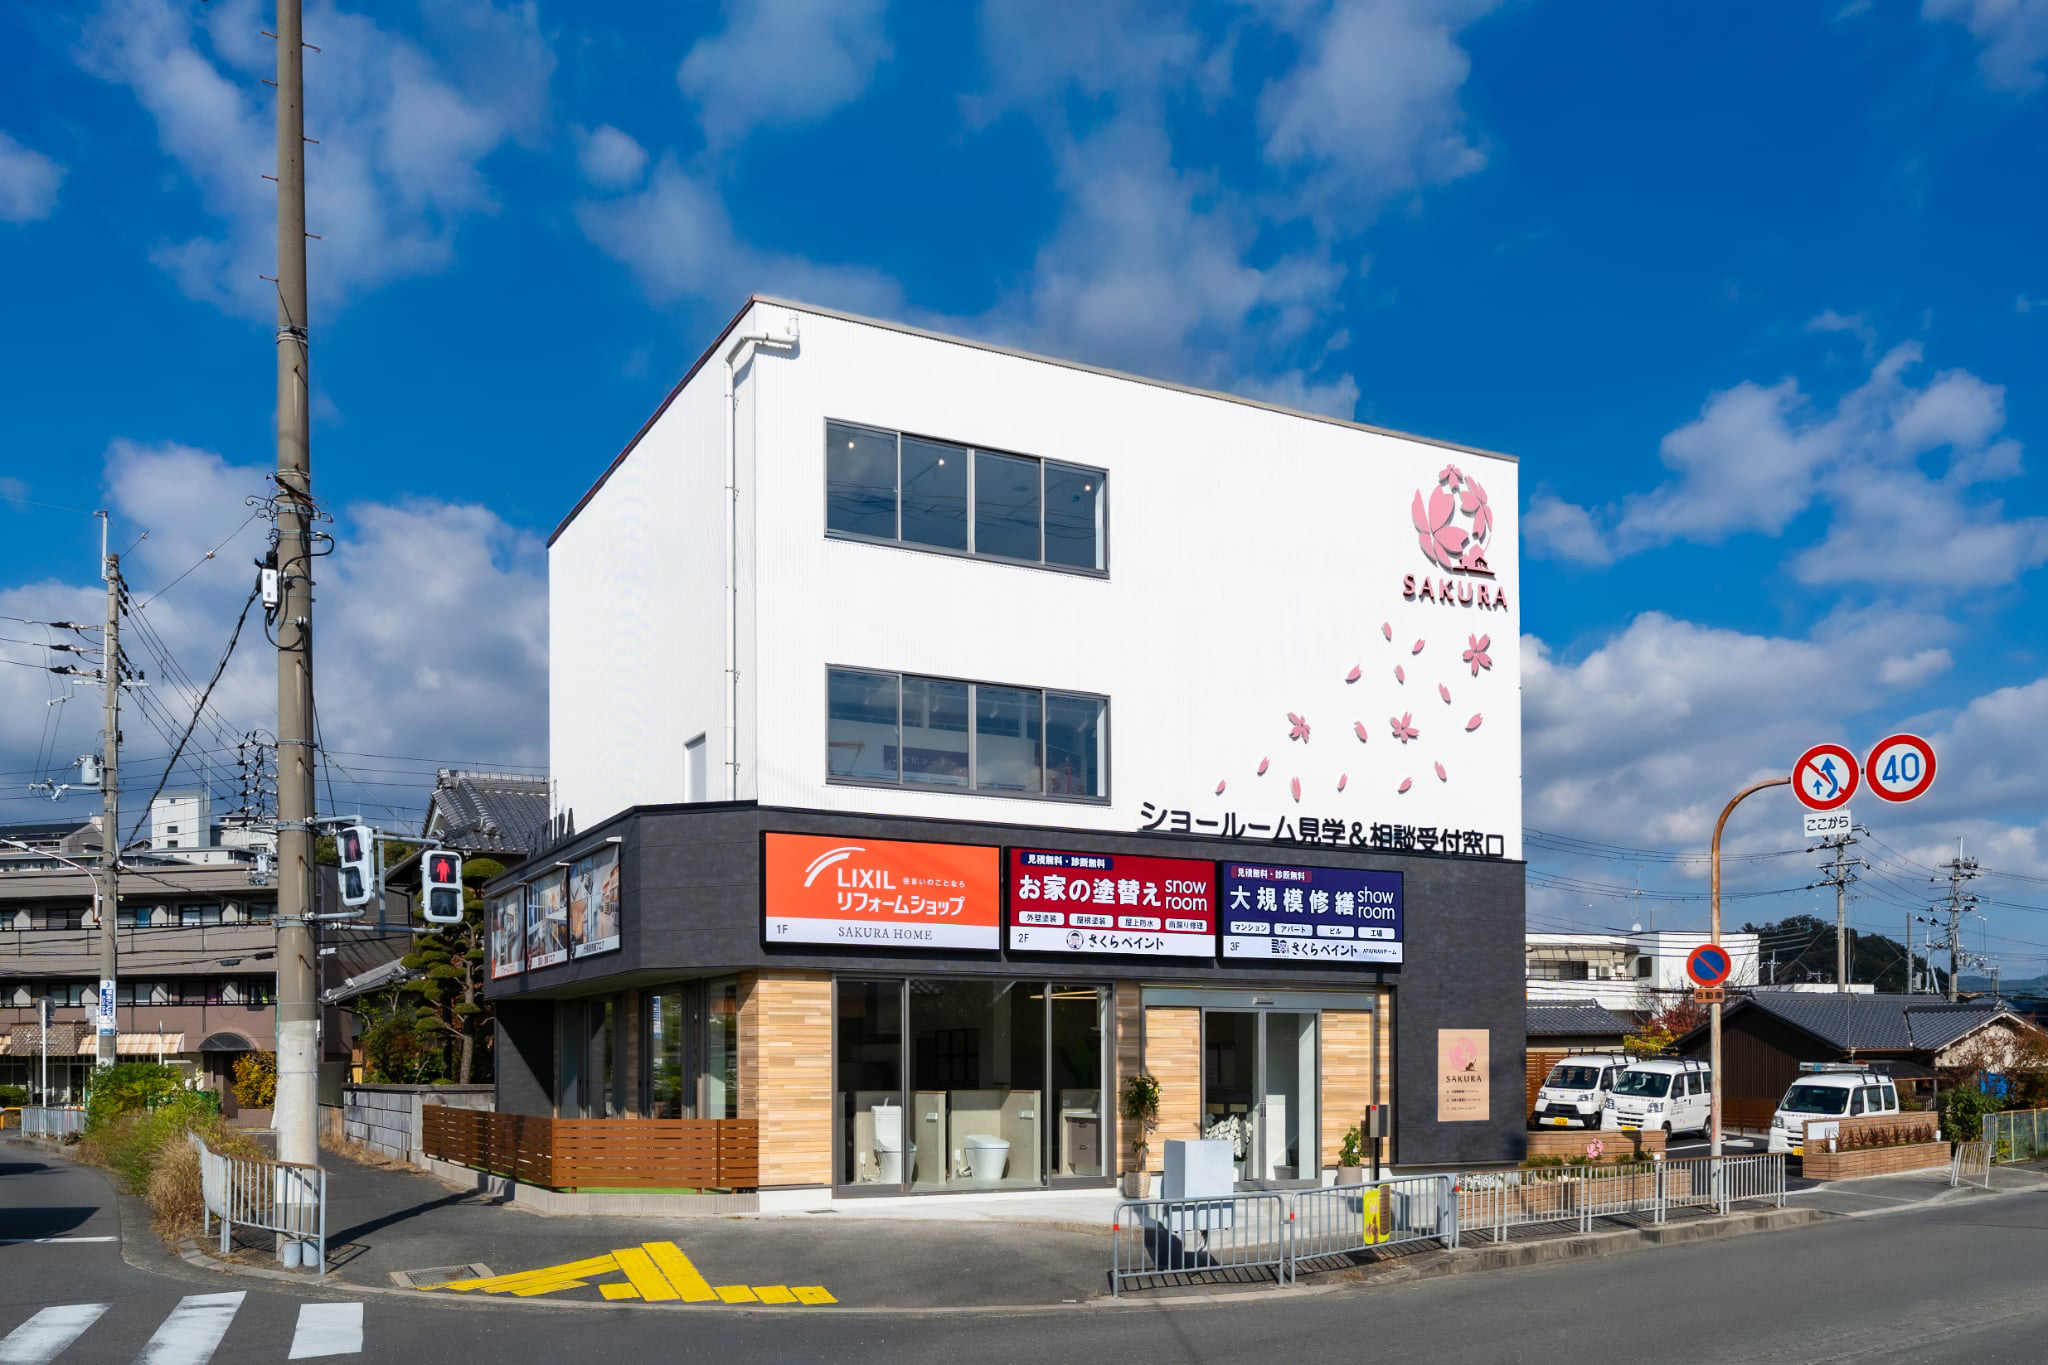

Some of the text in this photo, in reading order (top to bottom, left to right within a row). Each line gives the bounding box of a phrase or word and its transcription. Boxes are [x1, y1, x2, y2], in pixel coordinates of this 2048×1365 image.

[1403, 574, 1508, 609] SAKURA
[1882, 752, 1920, 784] 40
[1806, 816, 1849, 831] ここから
[837, 867, 897, 890] LIXIL
[902, 876, 966, 889] 住まいのことなら
[1018, 873, 1162, 907] お家の塗替え
[1357, 886, 1394, 905] show
[837, 891, 966, 916] リフォームショップ
[1165, 896, 1208, 911] room
[1229, 885, 1355, 916] 大規模修繕
[1026, 913, 1057, 923] 外壁塗装
[1357, 904, 1396, 920] room
[1076, 915, 1107, 926] 屋根塗装
[1125, 918, 1154, 928] 屋上防水
[1168, 920, 1204, 930] 雨漏り修理
[1233, 923, 1268, 933] マンション
[776, 924, 788, 935] 1F
[838, 926, 933, 941] SAKURA HOME
[1280, 925, 1306, 934] アパート
[1329, 927, 1342, 936] ビル
[1018, 933, 1030, 943] 2F
[1088, 933, 1164, 950] さくらペイント
[1230, 942, 1240, 952] 3F
[1291, 942, 1358, 957] さくらペイント
[1446, 1075, 1483, 1083] SAKURA
